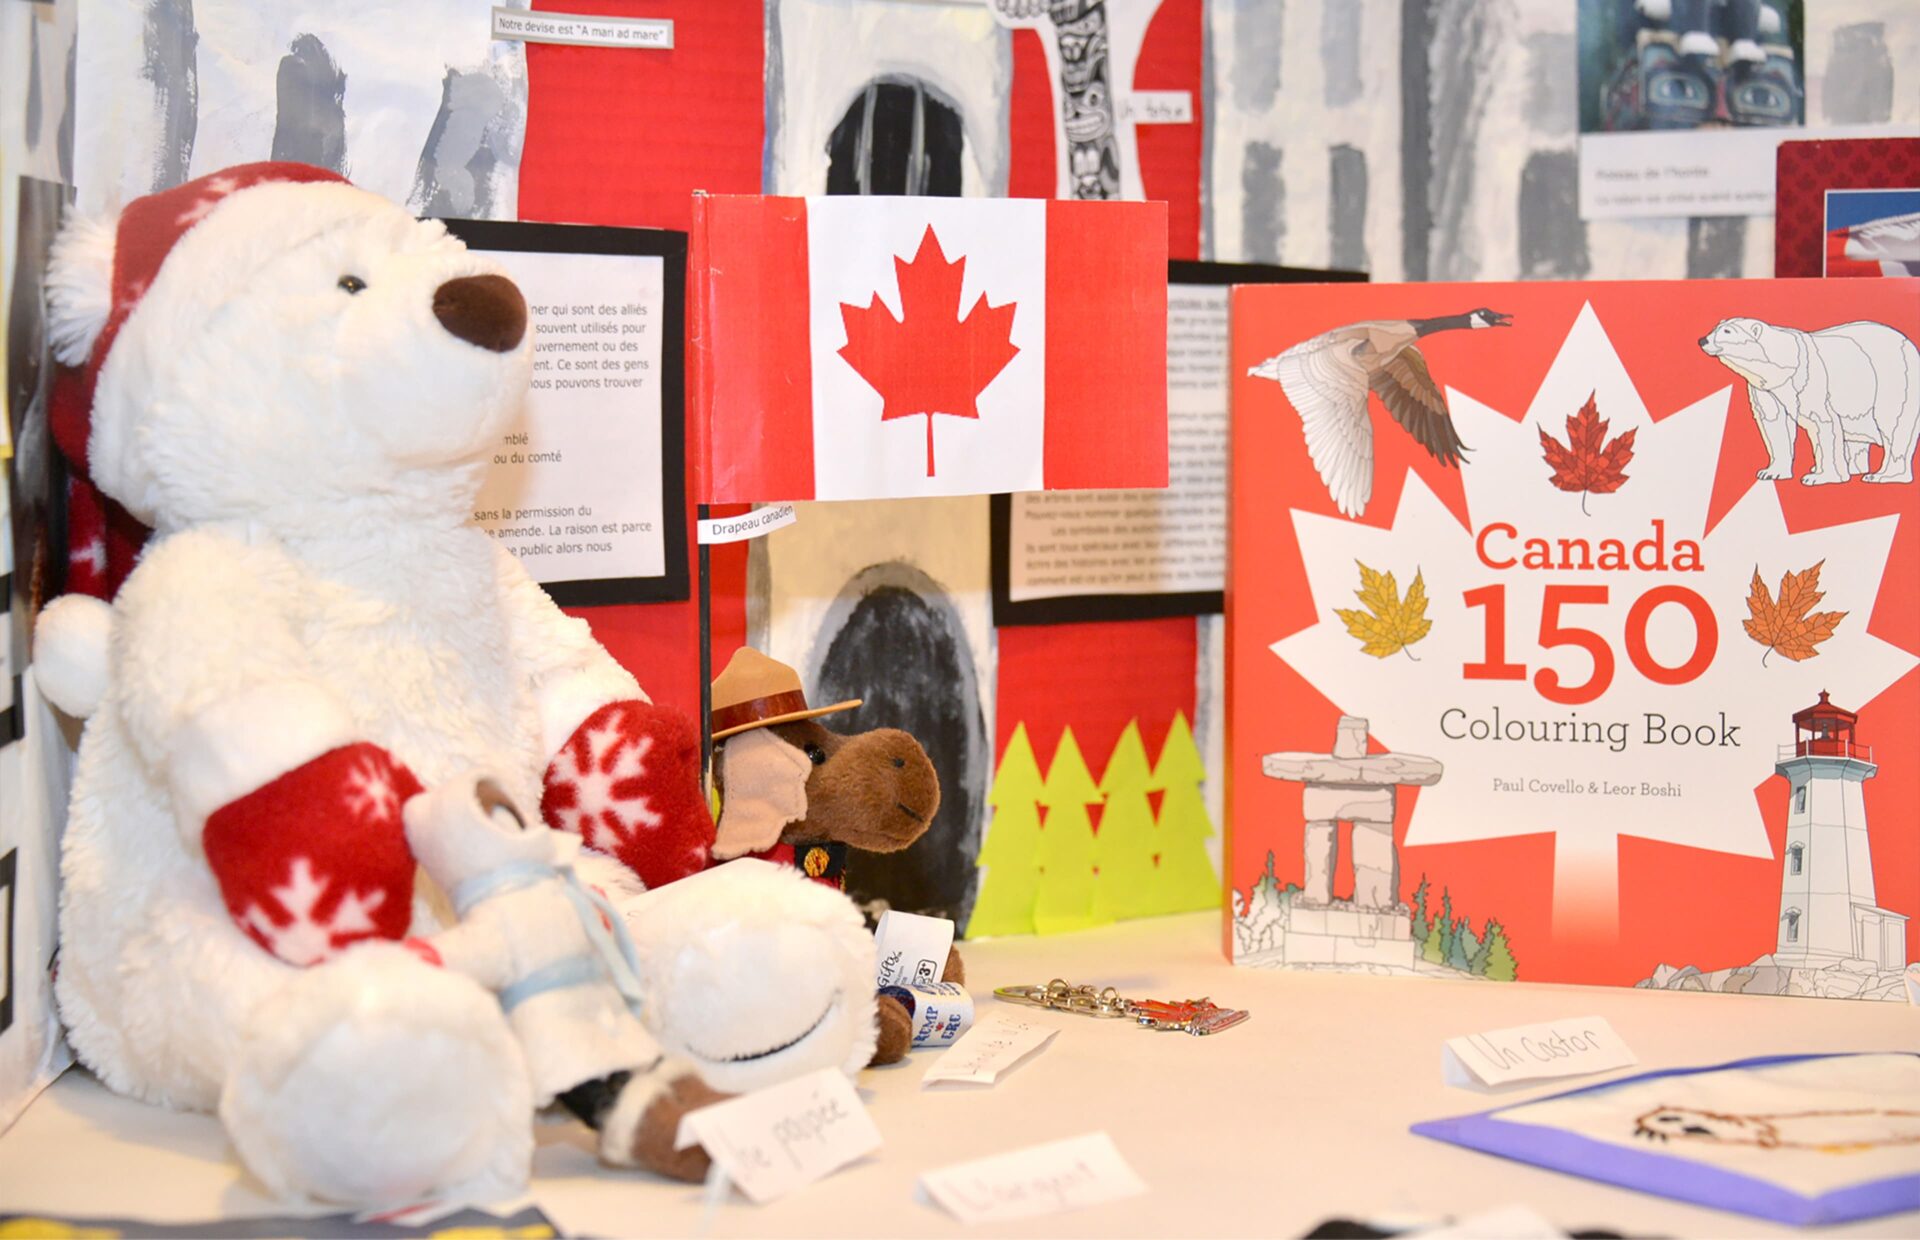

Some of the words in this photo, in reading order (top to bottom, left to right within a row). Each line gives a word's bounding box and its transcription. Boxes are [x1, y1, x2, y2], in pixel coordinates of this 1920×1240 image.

[499, 18, 523, 32] Notre
[525, 20, 555, 34] devise
[558, 25, 574, 35] est
[592, 27, 614, 38] mari
[617, 29, 630, 39] ad
[531, 305, 549, 315] ner
[552, 305, 569, 319] qui
[571, 304, 595, 315] sont
[598, 304, 618, 315] des
[620, 303, 648, 315] alliés
[535, 323, 578, 334] souvent
[581, 321, 619, 334] utilisés
[622, 324, 646, 338] pour
[535, 340, 597, 352] uvernement
[602, 341, 617, 352] ou
[619, 340, 639, 352] des
[533, 360, 554, 371] ent.
[557, 359, 573, 370] Ce
[575, 359, 598, 370] sont
[601, 358, 621, 370] des
[624, 361, 649, 374] gens
[555, 378, 601, 392] pouvons
[604, 376, 643, 388] trouver
[505, 432, 528, 445] mblé
[494, 454, 508, 464] ou
[511, 451, 525, 463] du
[528, 450, 562, 463] comté
[474, 511, 499, 521] sans
[502, 508, 512, 519] la
[515, 507, 575, 520] permission
[578, 505, 592, 516] du
[712, 518, 760, 535] Drapeau
[761, 505, 793, 525] canadien
[498, 526, 545, 538] amende.
[549, 525, 562, 536] La
[565, 523, 598, 535] raison
[601, 523, 617, 533] est
[621, 522, 652, 536] parce
[520, 543, 553, 558] public
[556, 542, 582, 554] alors
[586, 541, 612, 552] nous
[1475, 519, 1705, 572] Canada
[1462, 583, 1719, 706] 150
[1440, 706, 1630, 753] Colouring
[1643, 712, 1741, 747] Book
[1492, 778, 1525, 793] Paul
[1528, 779, 1585, 795] Covello
[1588, 782, 1600, 795] &
[1603, 781, 1637, 797] Leor
[1640, 782, 1683, 798] Boshi
[1465, 1033, 1524, 1071] Un
[1520, 1030, 1600, 1062] Castor
